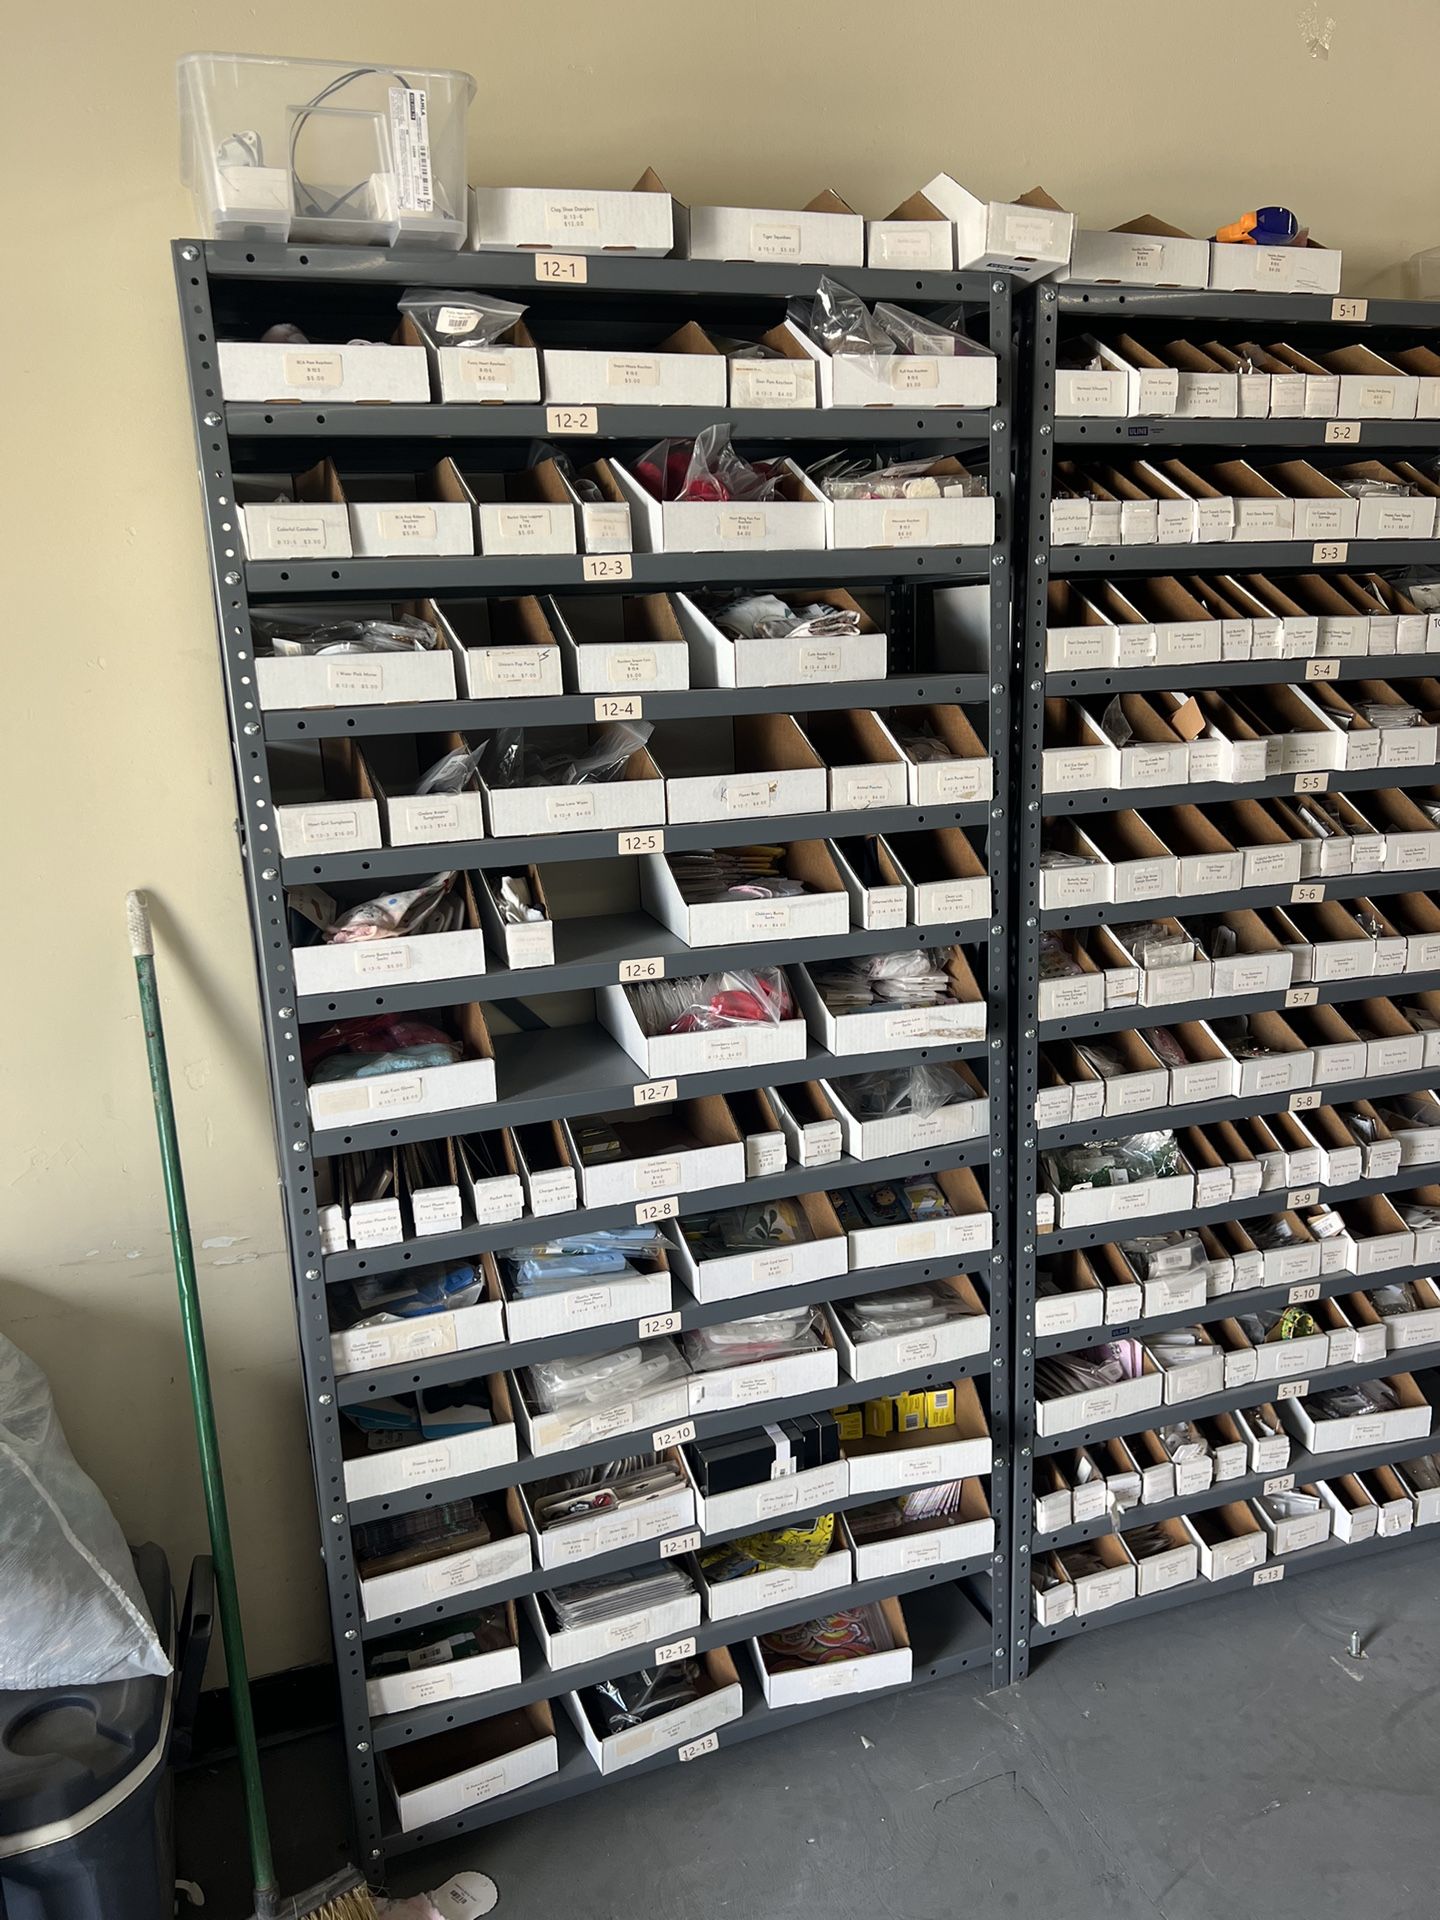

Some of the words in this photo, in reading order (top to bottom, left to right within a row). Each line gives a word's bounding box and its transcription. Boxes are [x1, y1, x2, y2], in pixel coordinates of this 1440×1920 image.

[543, 261, 575, 278] 12-1
[1340, 304, 1356, 317] 5-1
[554, 413, 588, 428] 12-2
[1333, 426, 1351, 439] 5-2
[1321, 547, 1338, 560] 5-3
[590, 560, 623, 576] 12-3
[1314, 664, 1330, 676] 5-4
[602, 702, 634, 716] 12-4
[1302, 777, 1319, 789] 5-5
[625, 836, 656, 850] 12-5
[1298, 888, 1316, 900] 5-6
[626, 963, 656, 977] 12-6
[1292, 992, 1310, 1004] 5-7
[640, 1085, 669, 1101] 12-7
[1296, 1096, 1312, 1108] 5-8
[1294, 1193, 1311, 1205] 5-9
[642, 1203, 672, 1220] 12-8
[1293, 1288, 1315, 1301] 5-10
[645, 1318, 673, 1333] 12-9
[1282, 1385, 1302, 1397] 5-11
[658, 1427, 690, 1446] 12-10
[1268, 1479, 1289, 1492] 5-12
[664, 1537, 694, 1553] 12-11
[1258, 1570, 1278, 1582] 5-13
[659, 1643, 690, 1660] 12-12
[682, 1738, 714, 1759] 12-13
